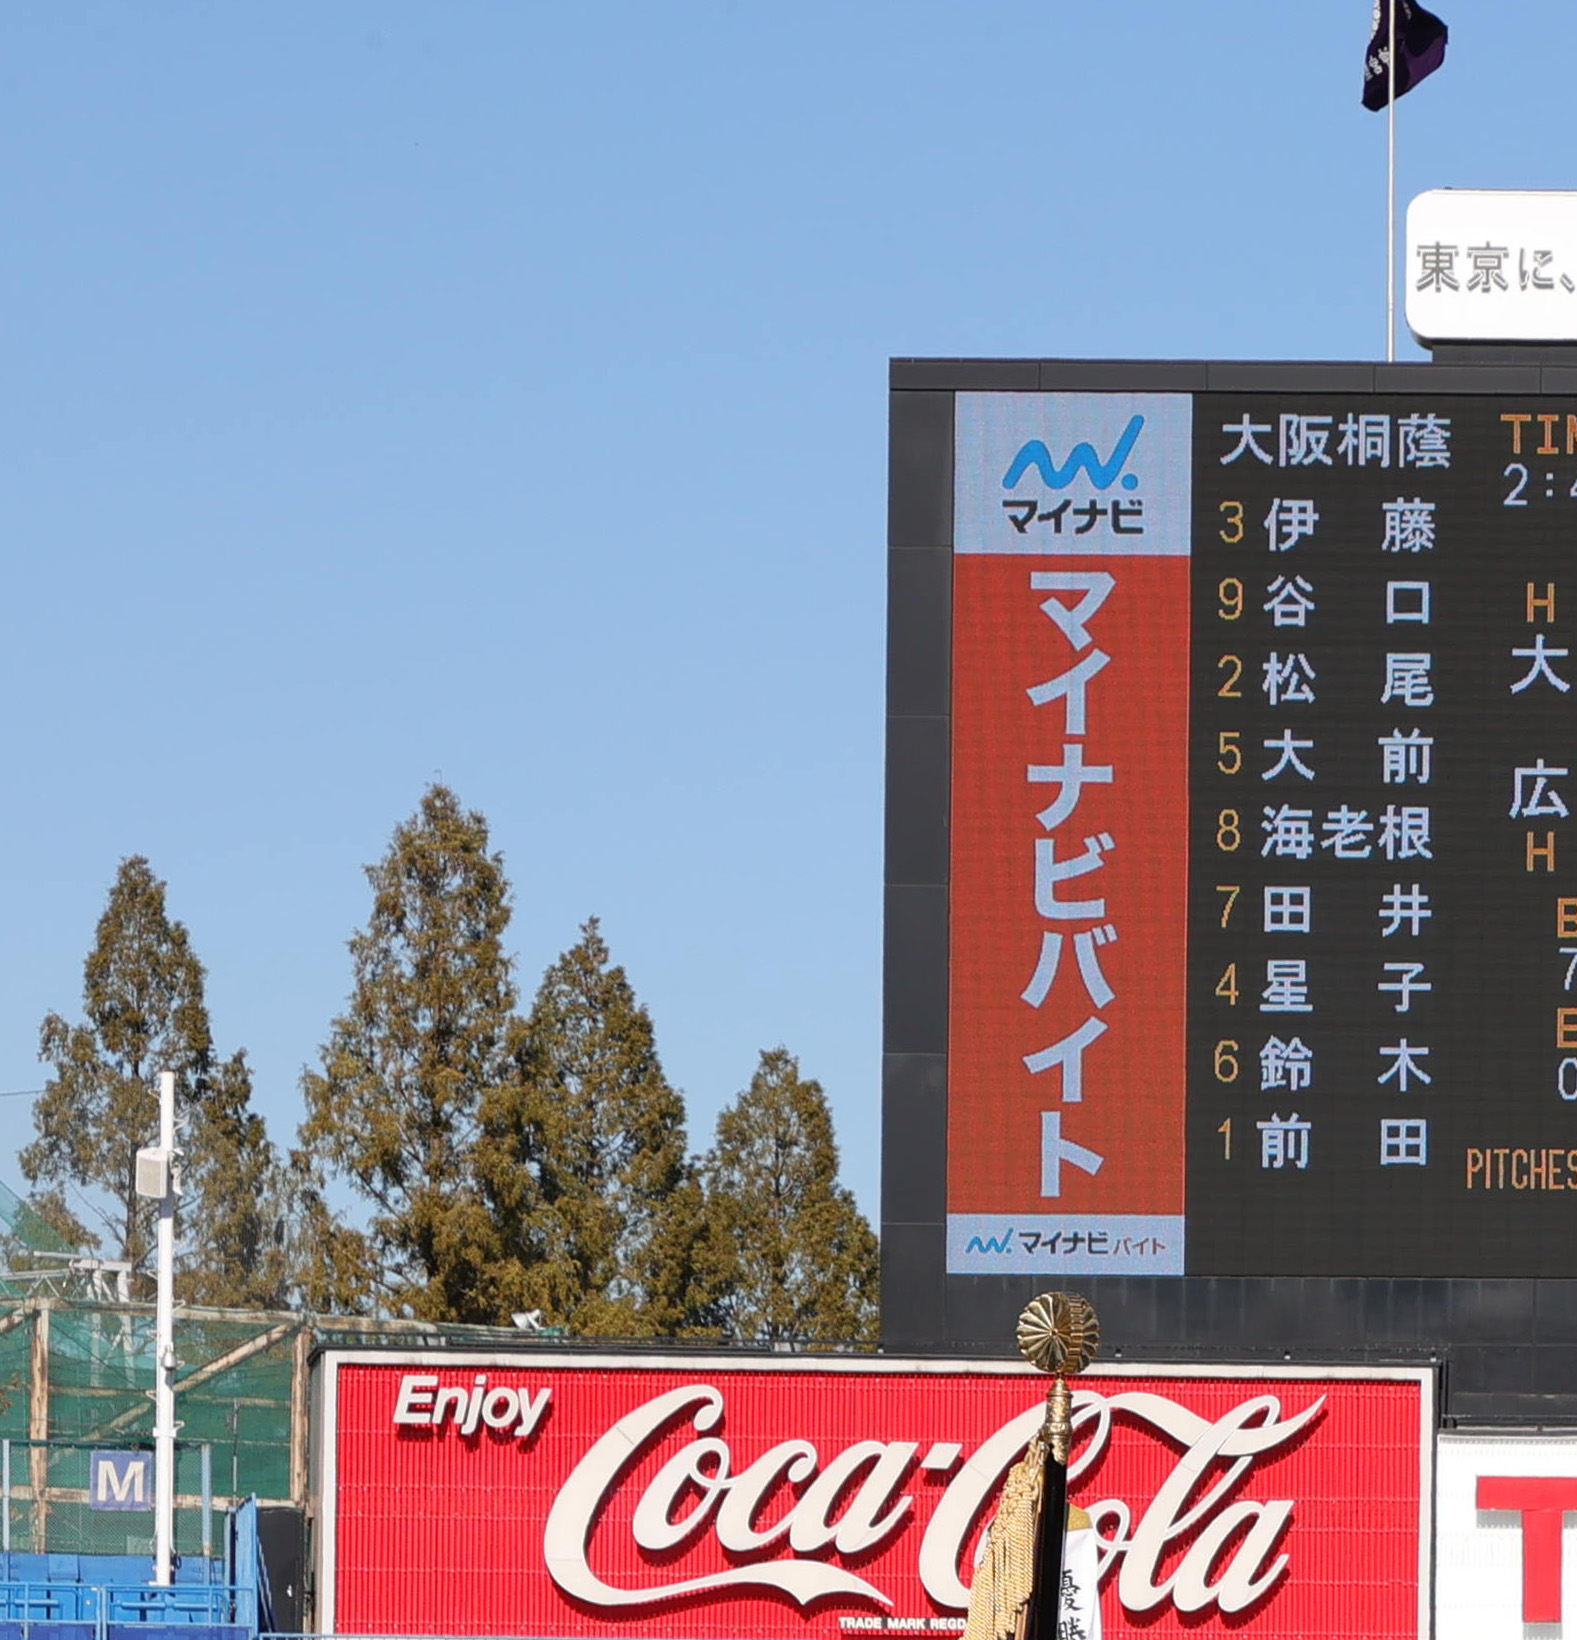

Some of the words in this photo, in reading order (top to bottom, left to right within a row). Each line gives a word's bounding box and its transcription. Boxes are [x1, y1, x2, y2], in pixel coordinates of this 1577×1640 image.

[1220, 413, 1450, 468] 大阪桐蔭
[1002, 499, 1143, 536] マイナビ
[1220, 502, 1243, 542] 3
[1219, 578, 1242, 619] 9
[1527, 583, 1554, 622] H
[1218, 655, 1241, 696] 2
[1510, 634, 1570, 694] 大
[1218, 732, 1241, 774] 5
[1509, 759, 1569, 818] 広
[1217, 809, 1240, 850] 8
[1261, 804, 1432, 860] 海老根
[1020, 571, 1118, 1198] マイナビバイト
[1217, 886, 1239, 927] 7
[1216, 963, 1239, 1005] 4
[1215, 1040, 1238, 1082] 6
[1218, 1118, 1230, 1159] 1
[1018, 1231, 1109, 1257] マイナビ
[1113, 1236, 1166, 1255] バイト
[394, 1374, 551, 1437] Enjoy
[98, 1460, 145, 1501] M
[838, 1617, 882, 1629] TRADE
[887, 1617, 926, 1629] MARK
[930, 1617, 967, 1630] REGD
